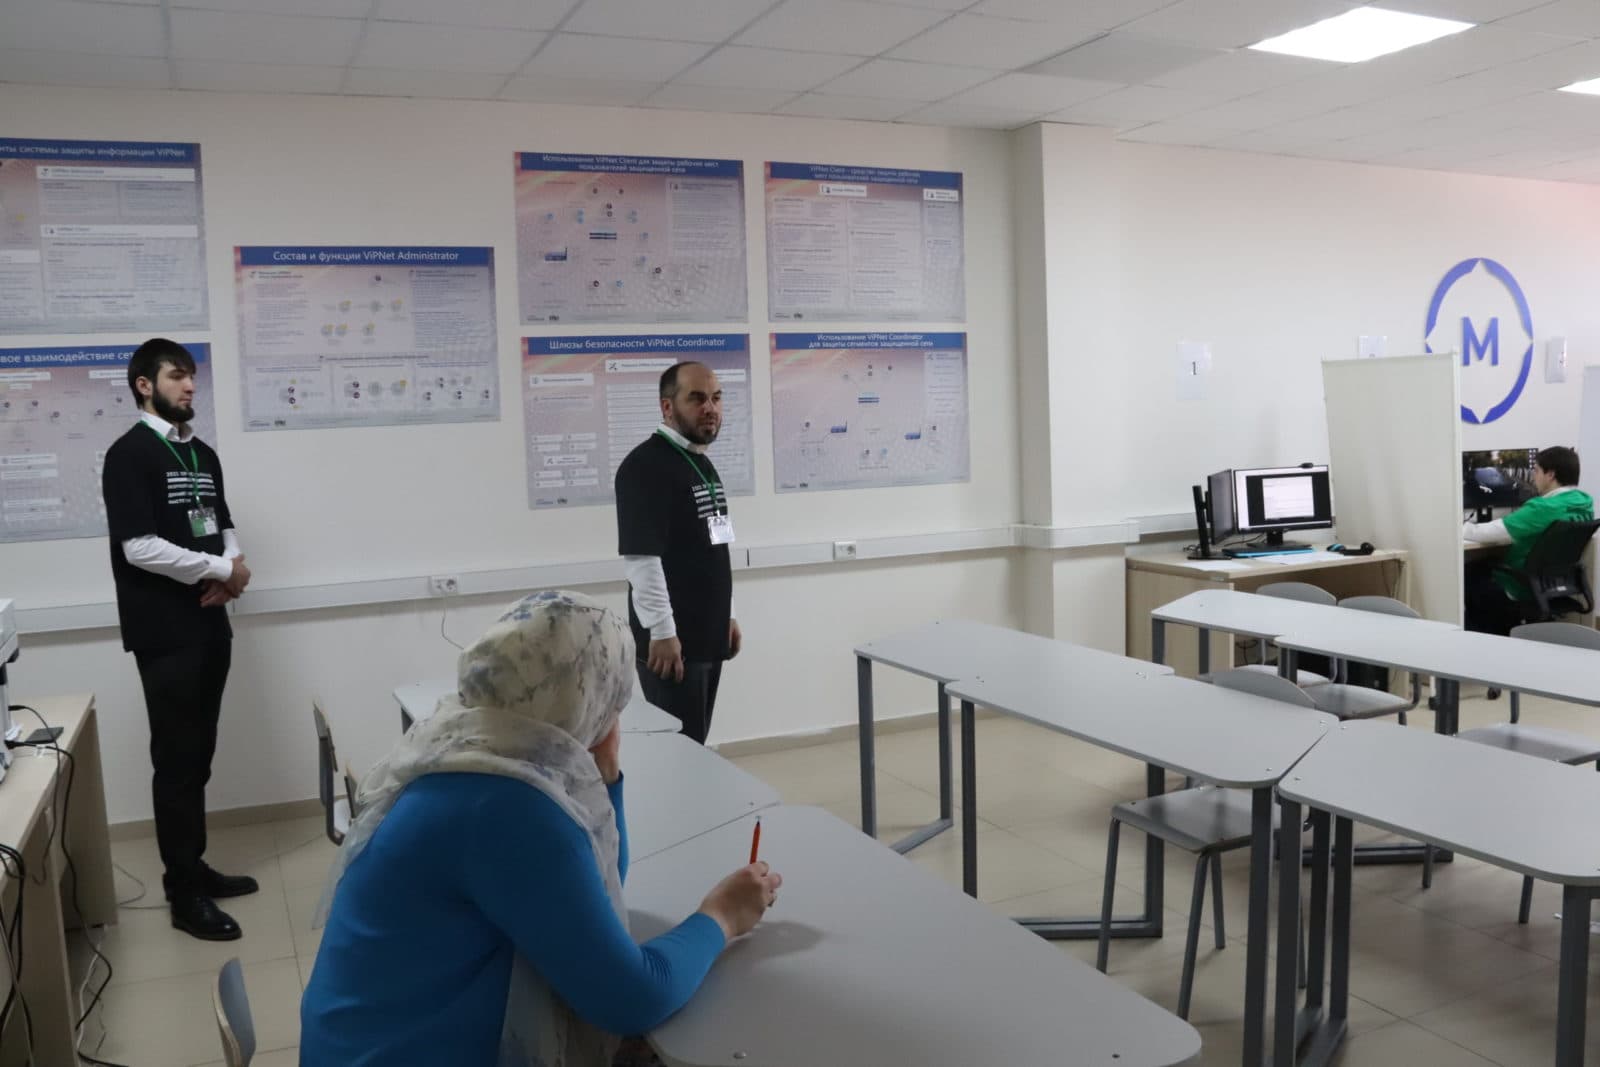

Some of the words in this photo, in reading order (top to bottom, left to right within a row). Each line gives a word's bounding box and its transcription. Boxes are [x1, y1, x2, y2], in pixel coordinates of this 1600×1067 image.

[20, 146, 58, 154] системы
[61, 148, 95, 156] защиты
[98, 147, 155, 157] информации
[273, 251, 307, 261] Состав
[319, 251, 361, 262] функции
[364, 251, 395, 260] ViPNet
[398, 252, 459, 260] Administrator
[550, 340, 583, 349] Шлюзы
[585, 339, 645, 347] безопасности
[677, 337, 726, 347] Coordinator
[24, 352, 115, 364] взаимодействие
[118, 352, 135, 360] сет
